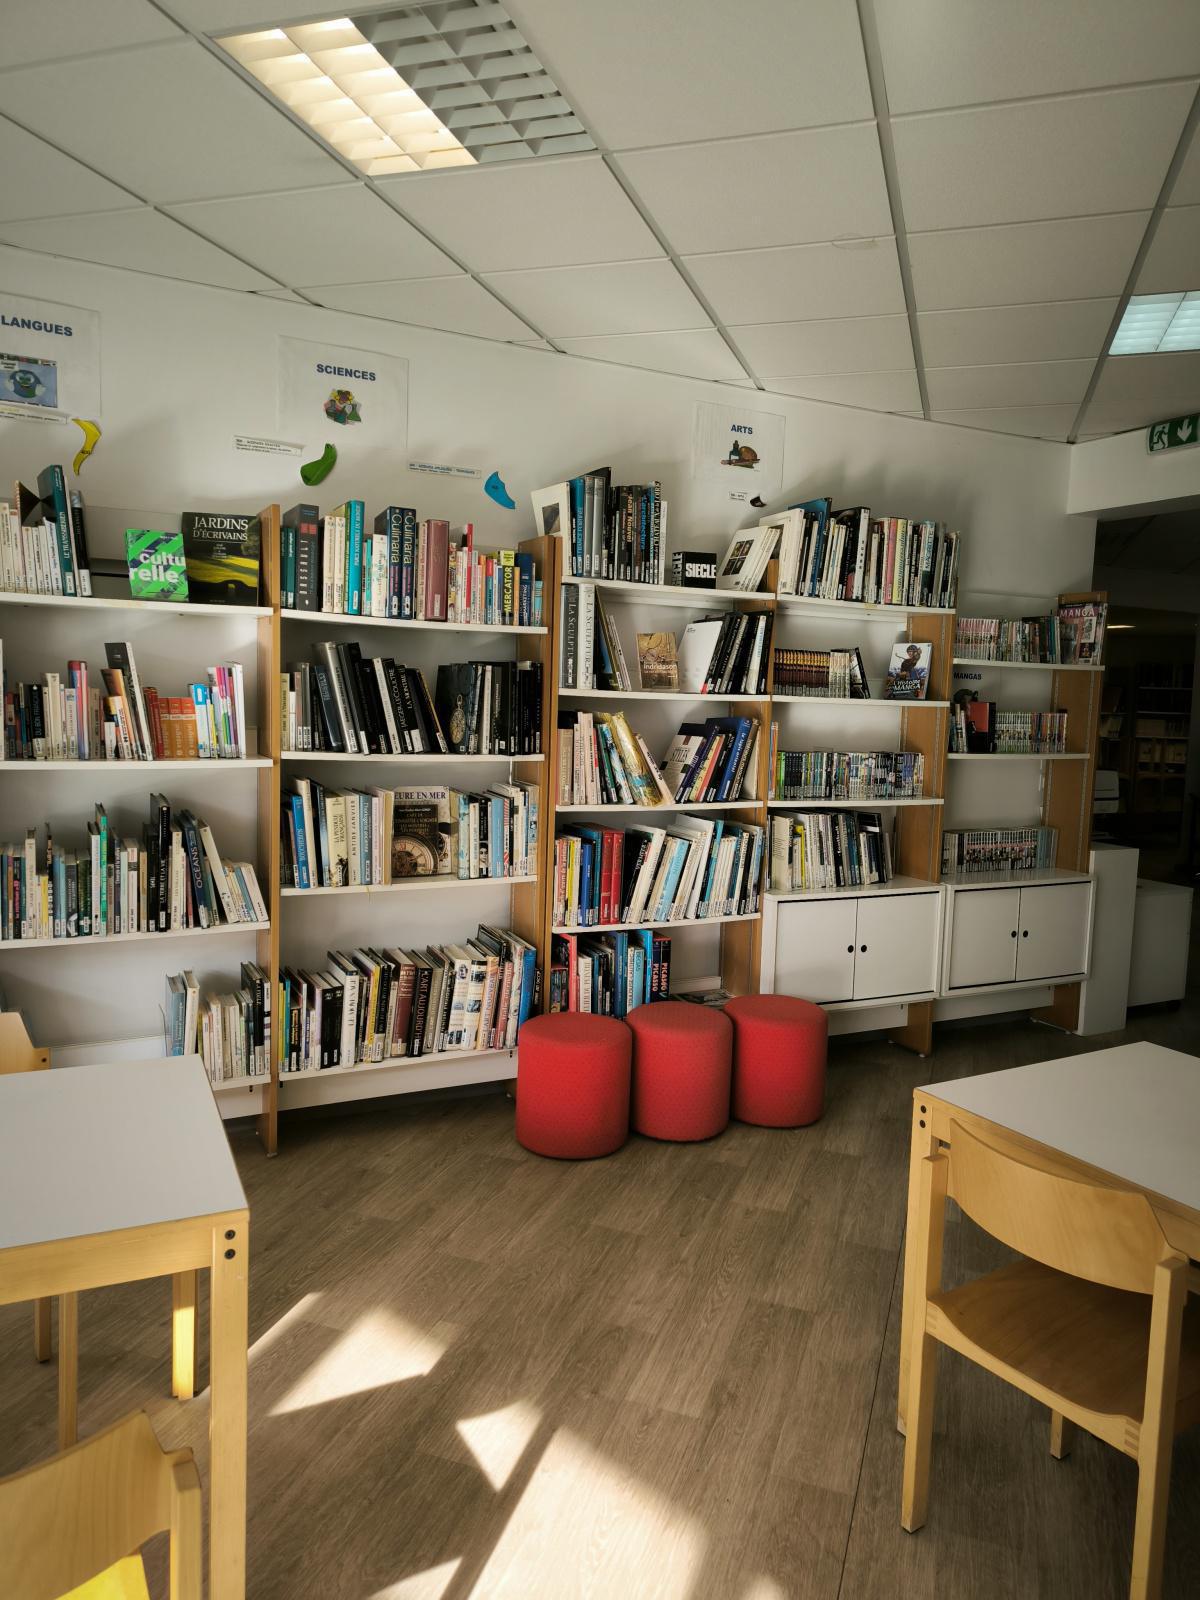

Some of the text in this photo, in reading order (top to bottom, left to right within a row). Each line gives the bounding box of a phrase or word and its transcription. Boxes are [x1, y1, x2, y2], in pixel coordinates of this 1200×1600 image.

[1, 315, 73, 337] LANGUES
[316, 363, 376, 381] SCIENCES
[731, 424, 753, 434] ARTS
[194, 516, 248, 530] JARDINS
[193, 529, 248, 540] D'ÉCRIVAINS
[391, 514, 402, 563] Culinaria
[403, 515, 415, 564] Culinaria
[140, 551, 186, 566] cultu
[129, 565, 180, 583] relle
[685, 563, 717, 579] SIECLE
[503, 566, 513, 612] MERCATOR
[586, 602, 593, 613] LA
[1060, 609, 1095, 617] MANGA
[568, 604, 577, 658] LA SCULPTU
[953, 672, 982, 680] MANGAS
[394, 791, 446, 800] EURE EN MER
[415, 972, 428, 1041] L'ART AUJOURD'H
